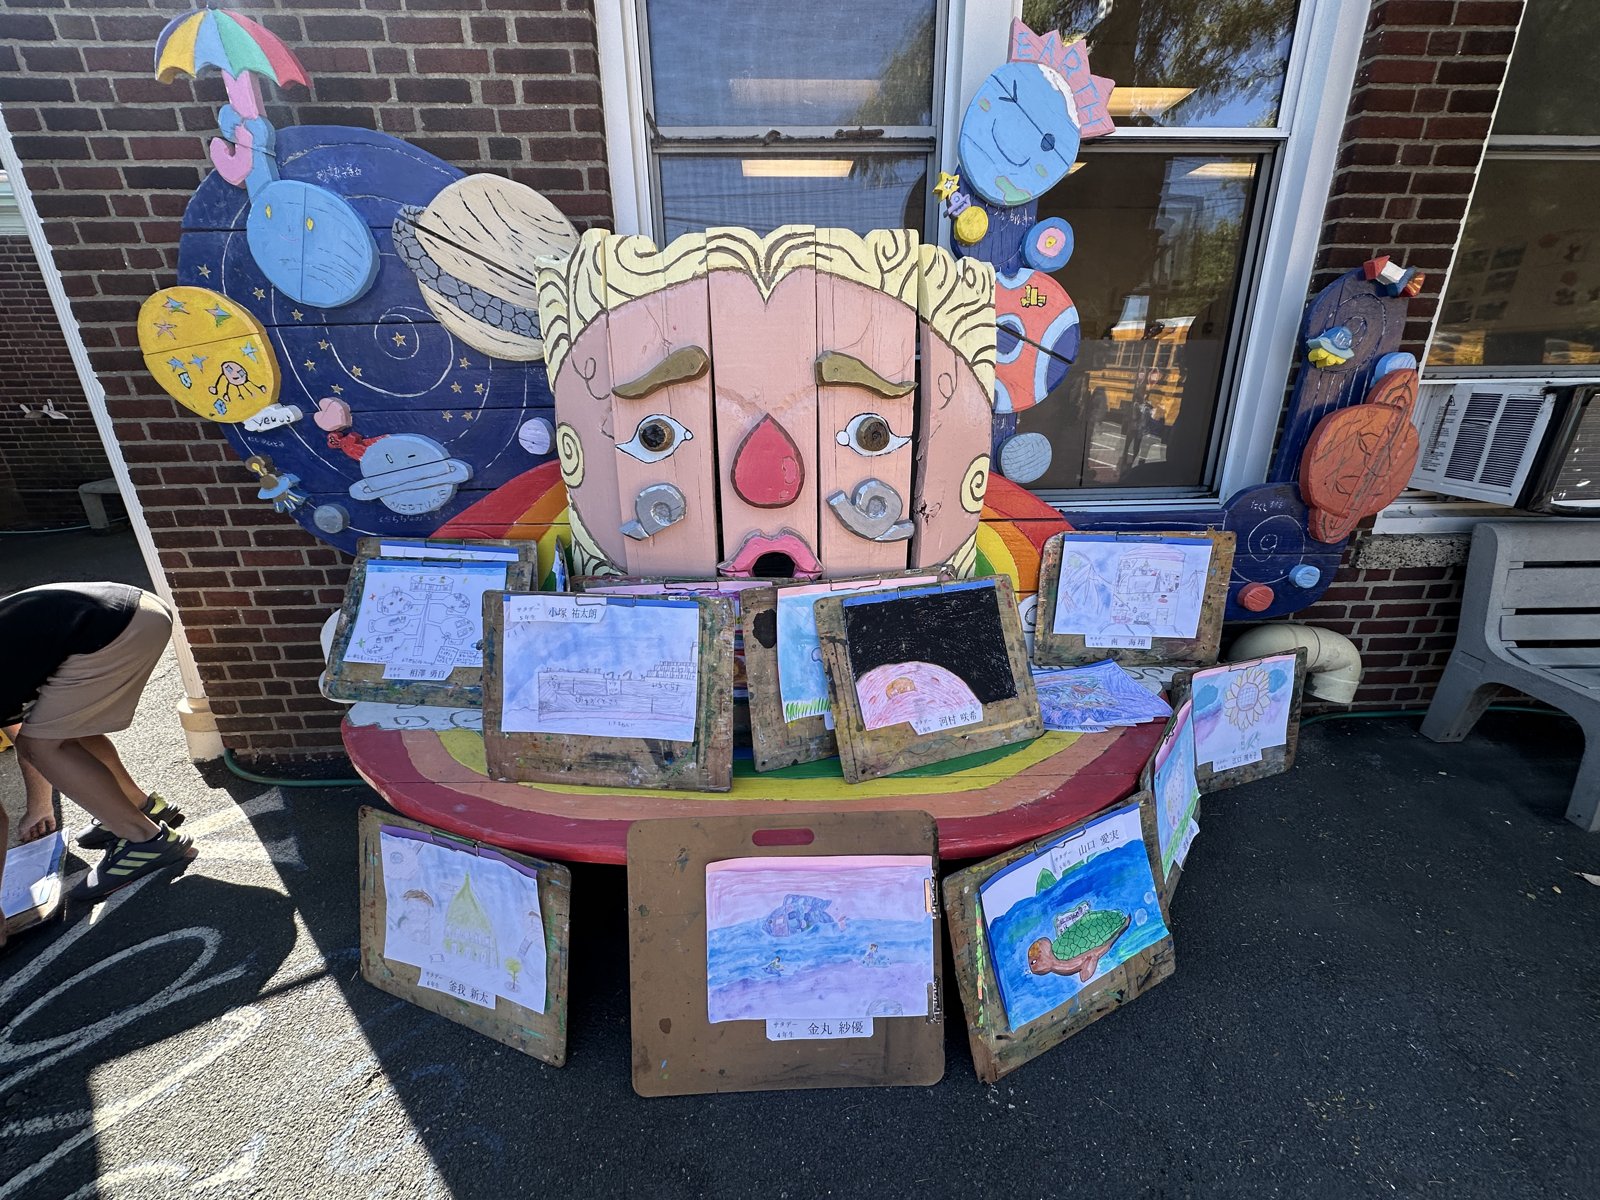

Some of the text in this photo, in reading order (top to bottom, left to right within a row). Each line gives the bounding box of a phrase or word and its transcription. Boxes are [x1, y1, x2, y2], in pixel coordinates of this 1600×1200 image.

[1017, 31, 1105, 127] EARTH
[1078, 839, 1096, 856] 山口
[807, 1022, 833, 1036] 金丸
